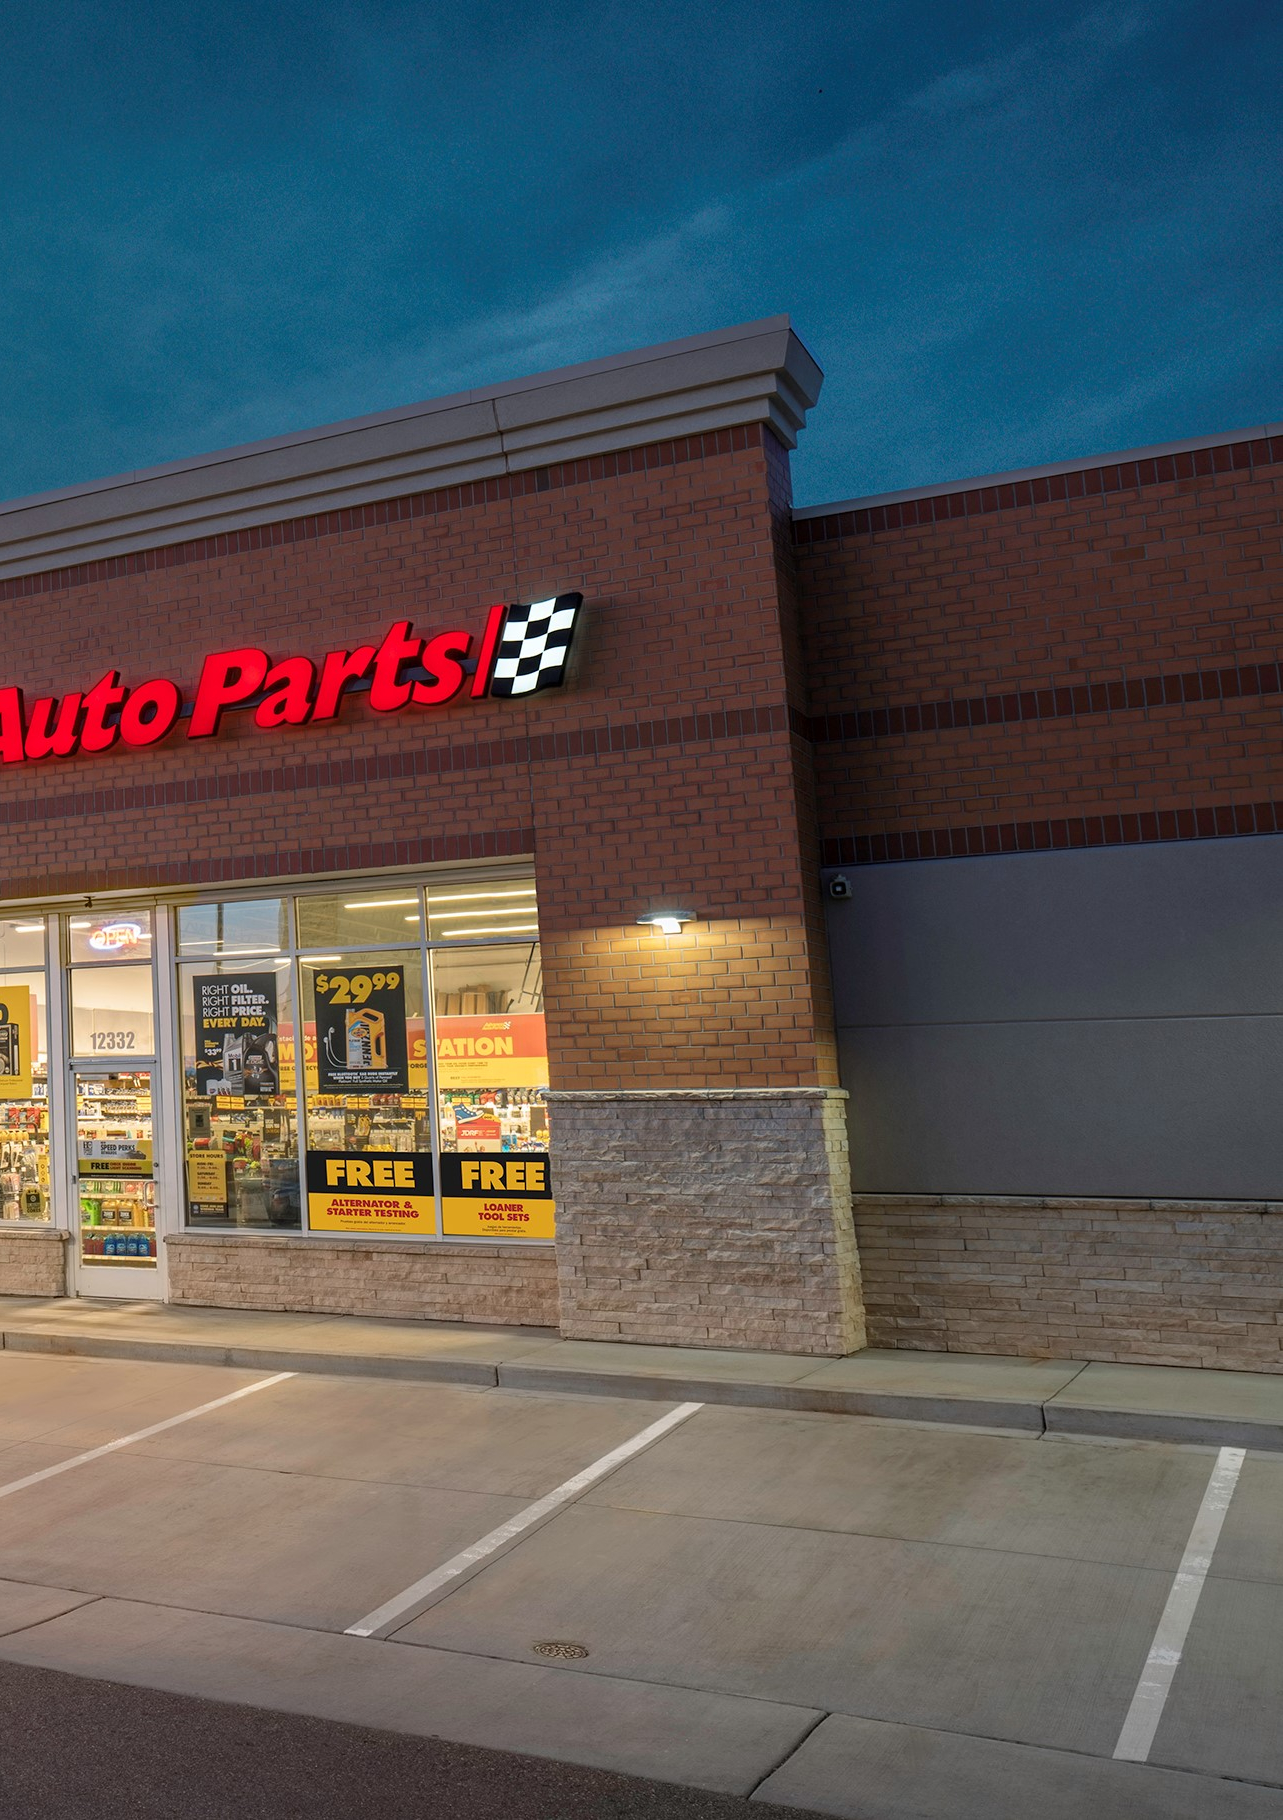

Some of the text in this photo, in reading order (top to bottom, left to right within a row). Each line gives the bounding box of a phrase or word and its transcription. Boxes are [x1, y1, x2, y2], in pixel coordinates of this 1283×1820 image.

[188, 620, 471, 738] Parts
[92, 929, 138, 946] OPEN
[201, 984, 253, 996] RIGHT OIL.
[202, 995, 269, 1006] RIGHT FILTER.
[202, 1006, 266, 1017] RIGHT PRICE.
[203, 1017, 265, 1028] EVERY DAY.
[90, 1031, 135, 1050] 12332
[413, 1036, 513, 1058] SATION
[325, 1159, 415, 1188] FREE
[461, 1160, 545, 1191] FREE
[331, 1199, 413, 1209] ALTERNATOR &
[484, 1203, 523, 1212] LOANER
[326, 1208, 419, 1218] STARTER TESTING
[478, 1212, 530, 1221] TOOL SETS
